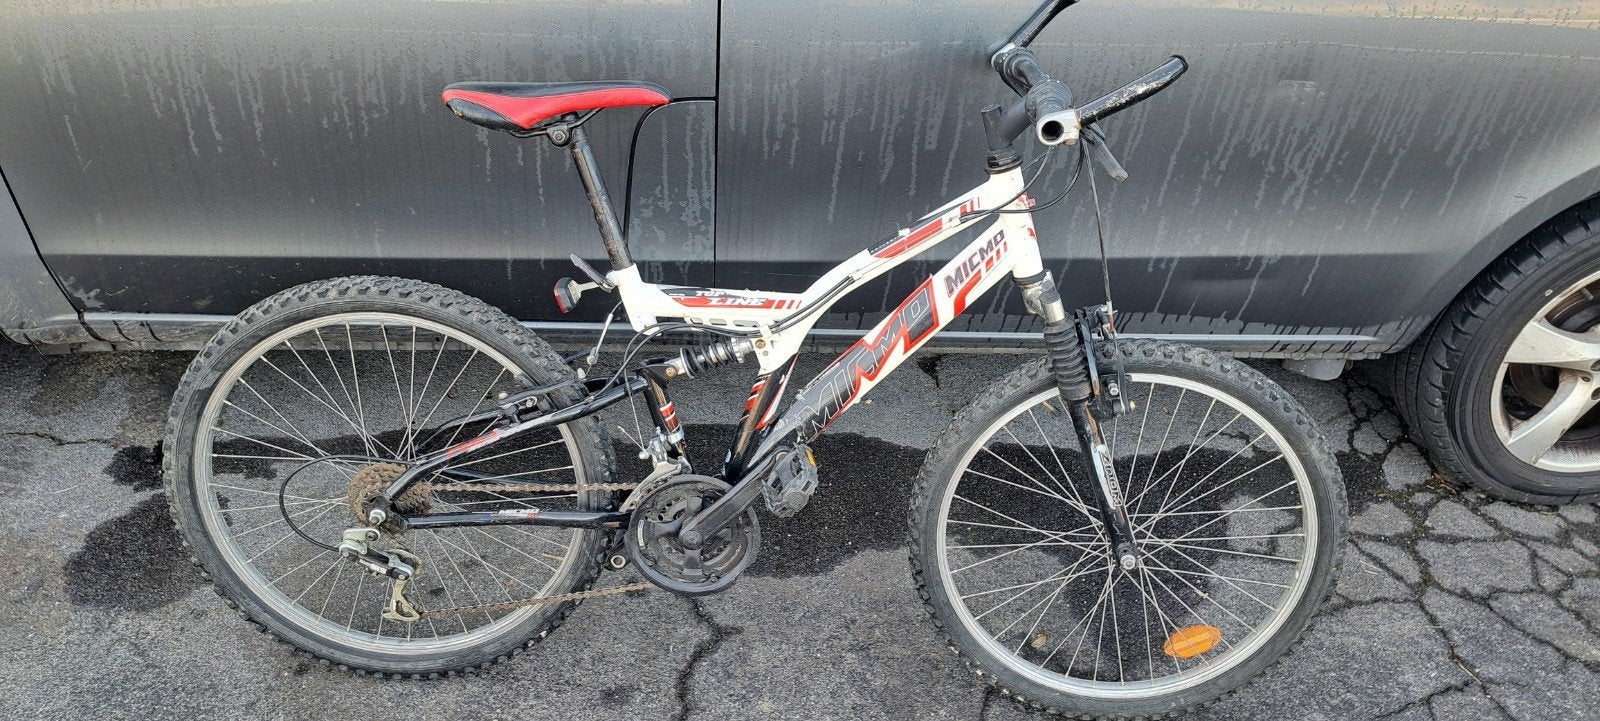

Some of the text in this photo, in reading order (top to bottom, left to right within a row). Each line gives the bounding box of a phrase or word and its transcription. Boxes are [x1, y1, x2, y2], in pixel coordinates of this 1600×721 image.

[944, 229, 1005, 298] MICMO
[695, 289, 727, 298] TOP
[708, 296, 769, 307] LINE
[798, 287, 930, 435] MICMO
